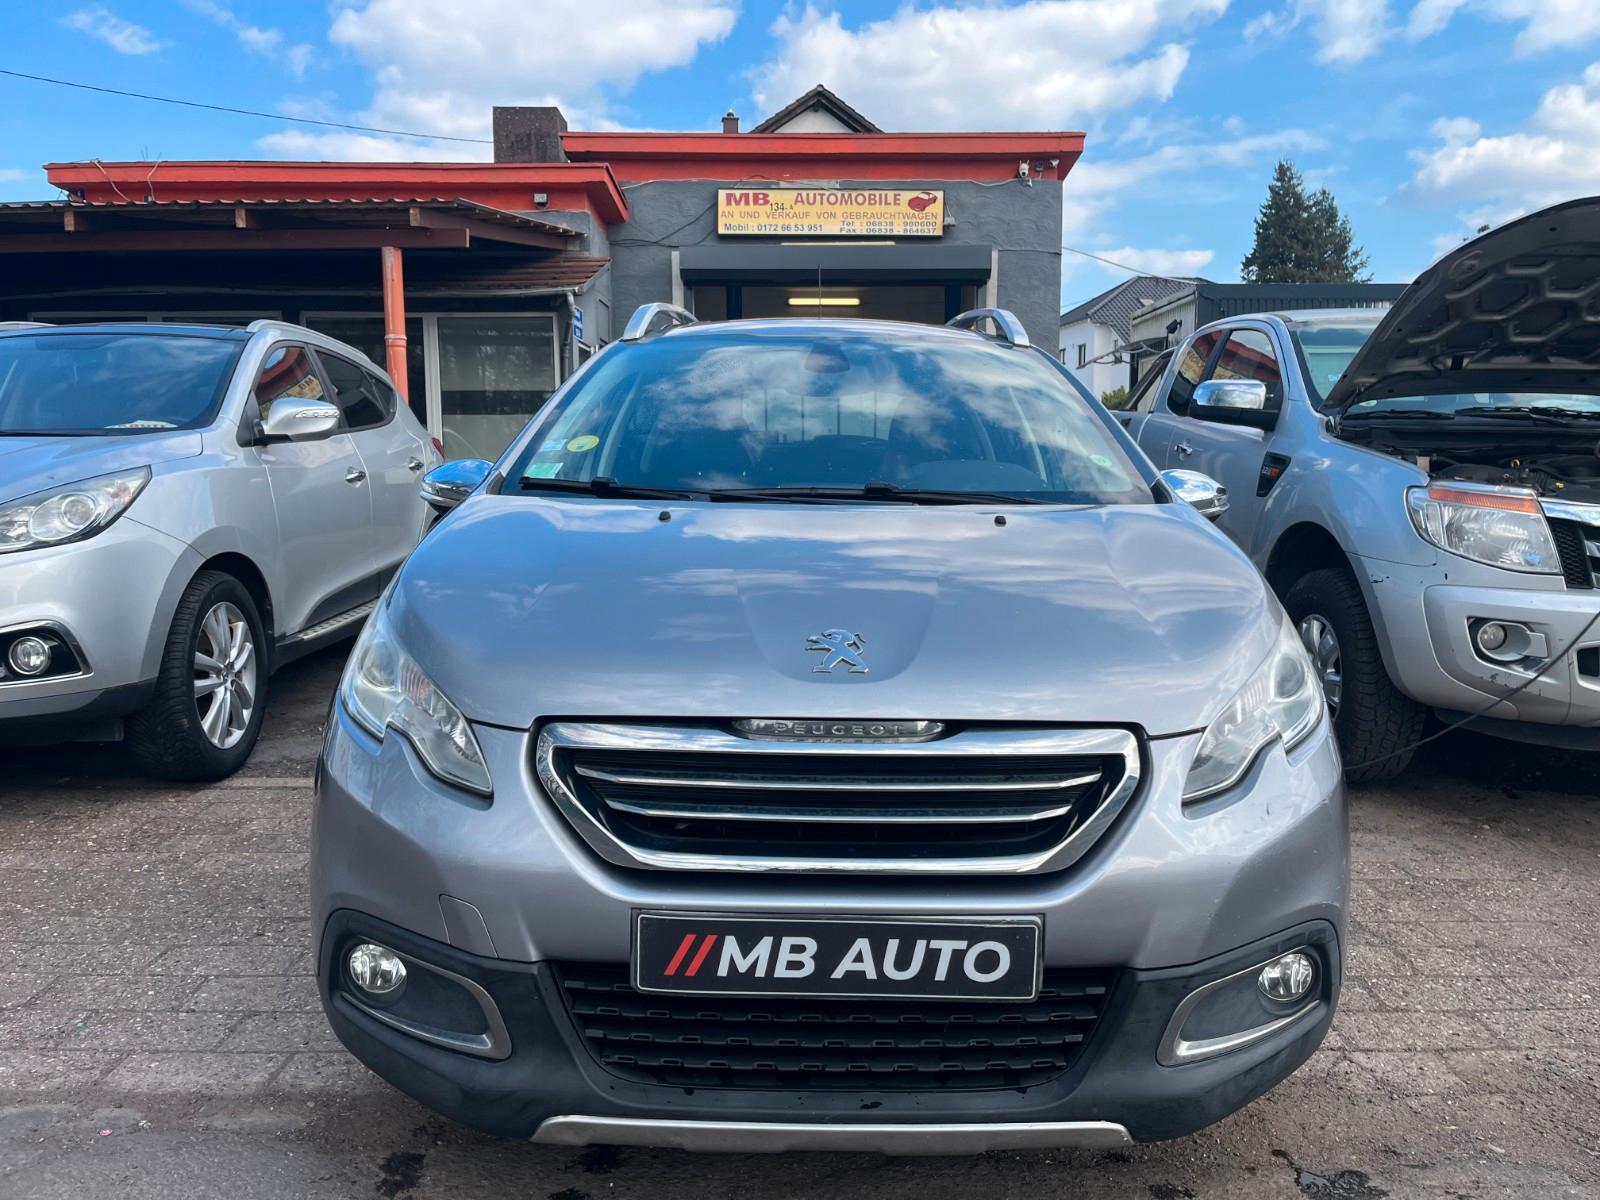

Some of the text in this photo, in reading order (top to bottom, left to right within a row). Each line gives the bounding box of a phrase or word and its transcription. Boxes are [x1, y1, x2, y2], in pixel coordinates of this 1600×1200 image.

[725, 192, 902, 206] MB AUTOMOBILE
[720, 210, 938, 221] AN UND VERKAUF VON GEBRAUCHTWAGEN
[724, 223, 749, 232] Mobil
[757, 224, 778, 232] 0172
[781, 224, 791, 232] 66
[794, 224, 804, 232] 53
[807, 224, 823, 232] 951
[773, 722, 904, 735] PEUGEOT
[716, 935, 1011, 983] MB AUTO
